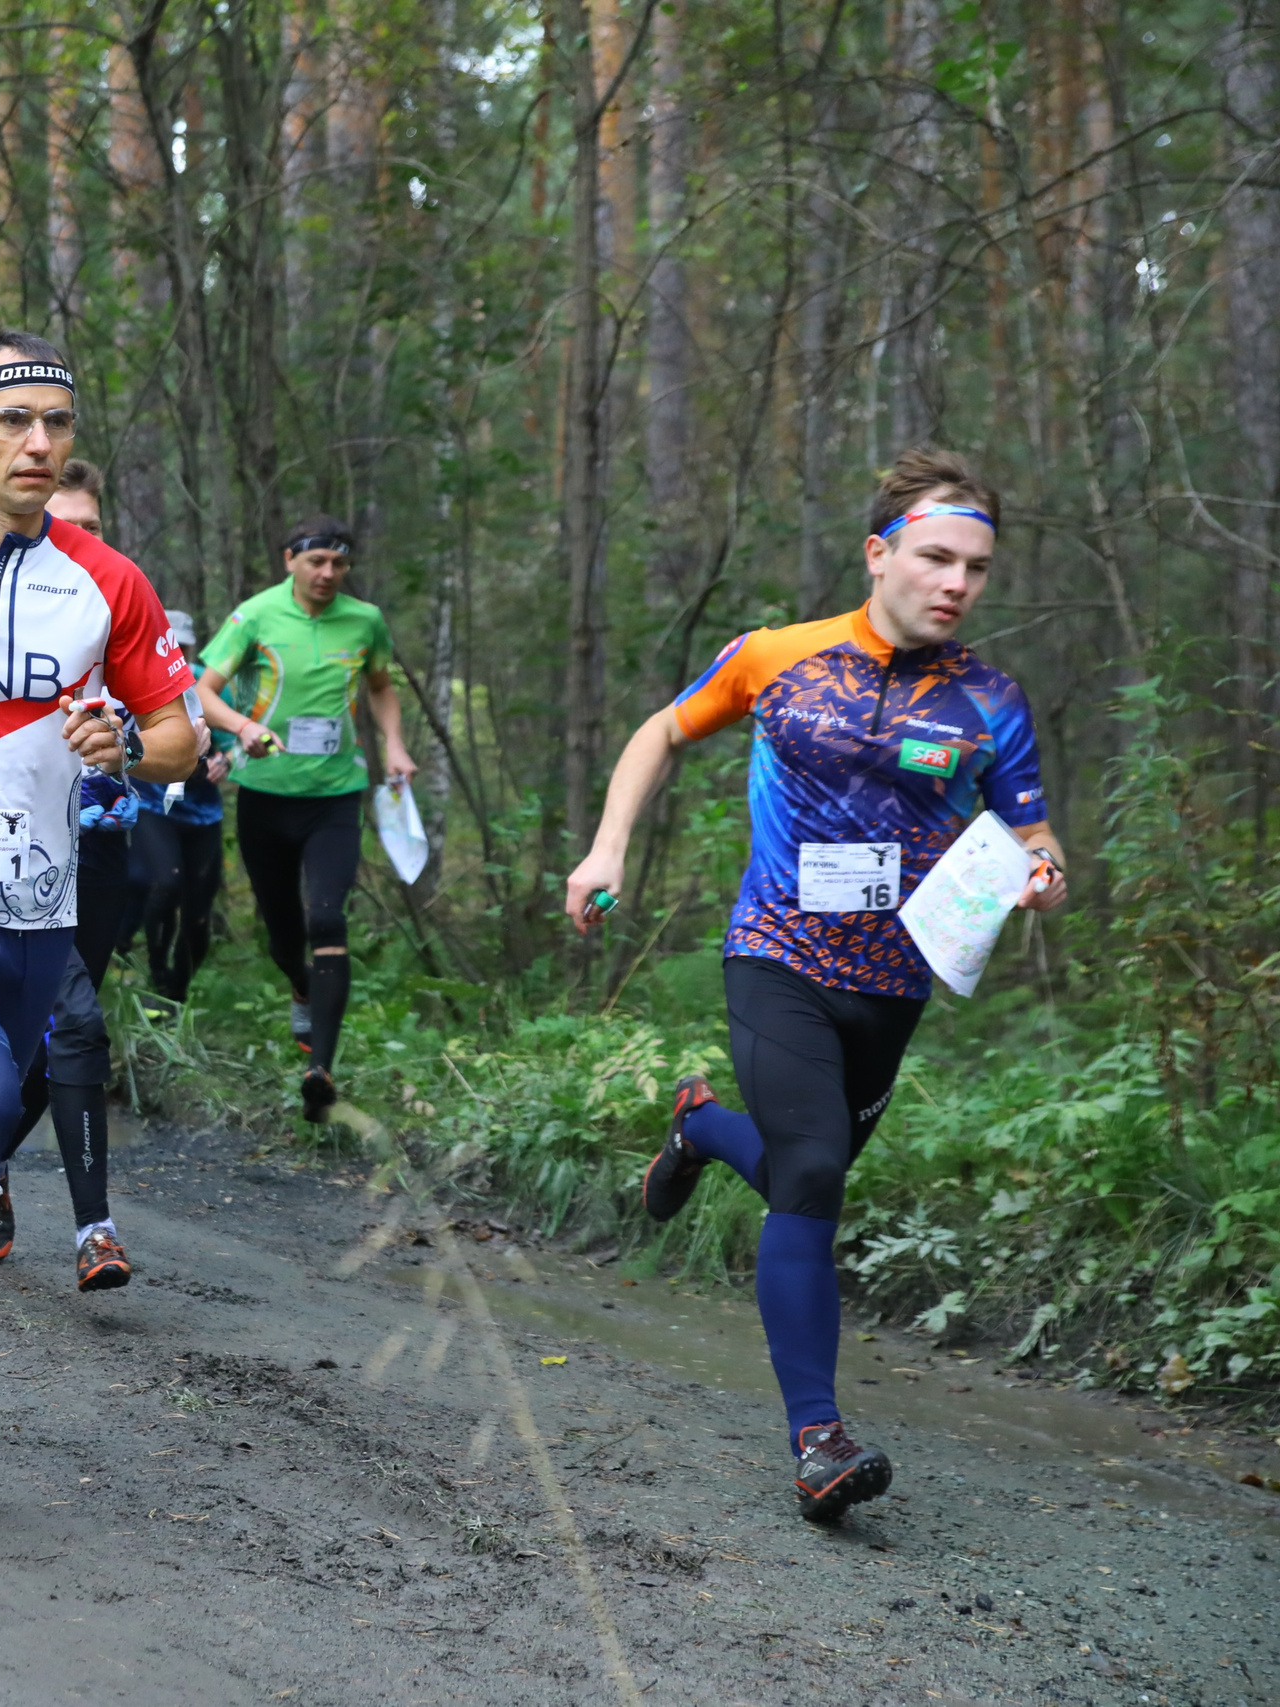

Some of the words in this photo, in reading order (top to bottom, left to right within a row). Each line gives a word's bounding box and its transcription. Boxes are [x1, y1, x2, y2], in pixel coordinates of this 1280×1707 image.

[27, 583, 78, 596] noname
[324, 739, 337, 752] 17
[911, 747, 947, 765] SFR
[11, 854, 21, 880] 1
[861, 884, 891, 908] 16
